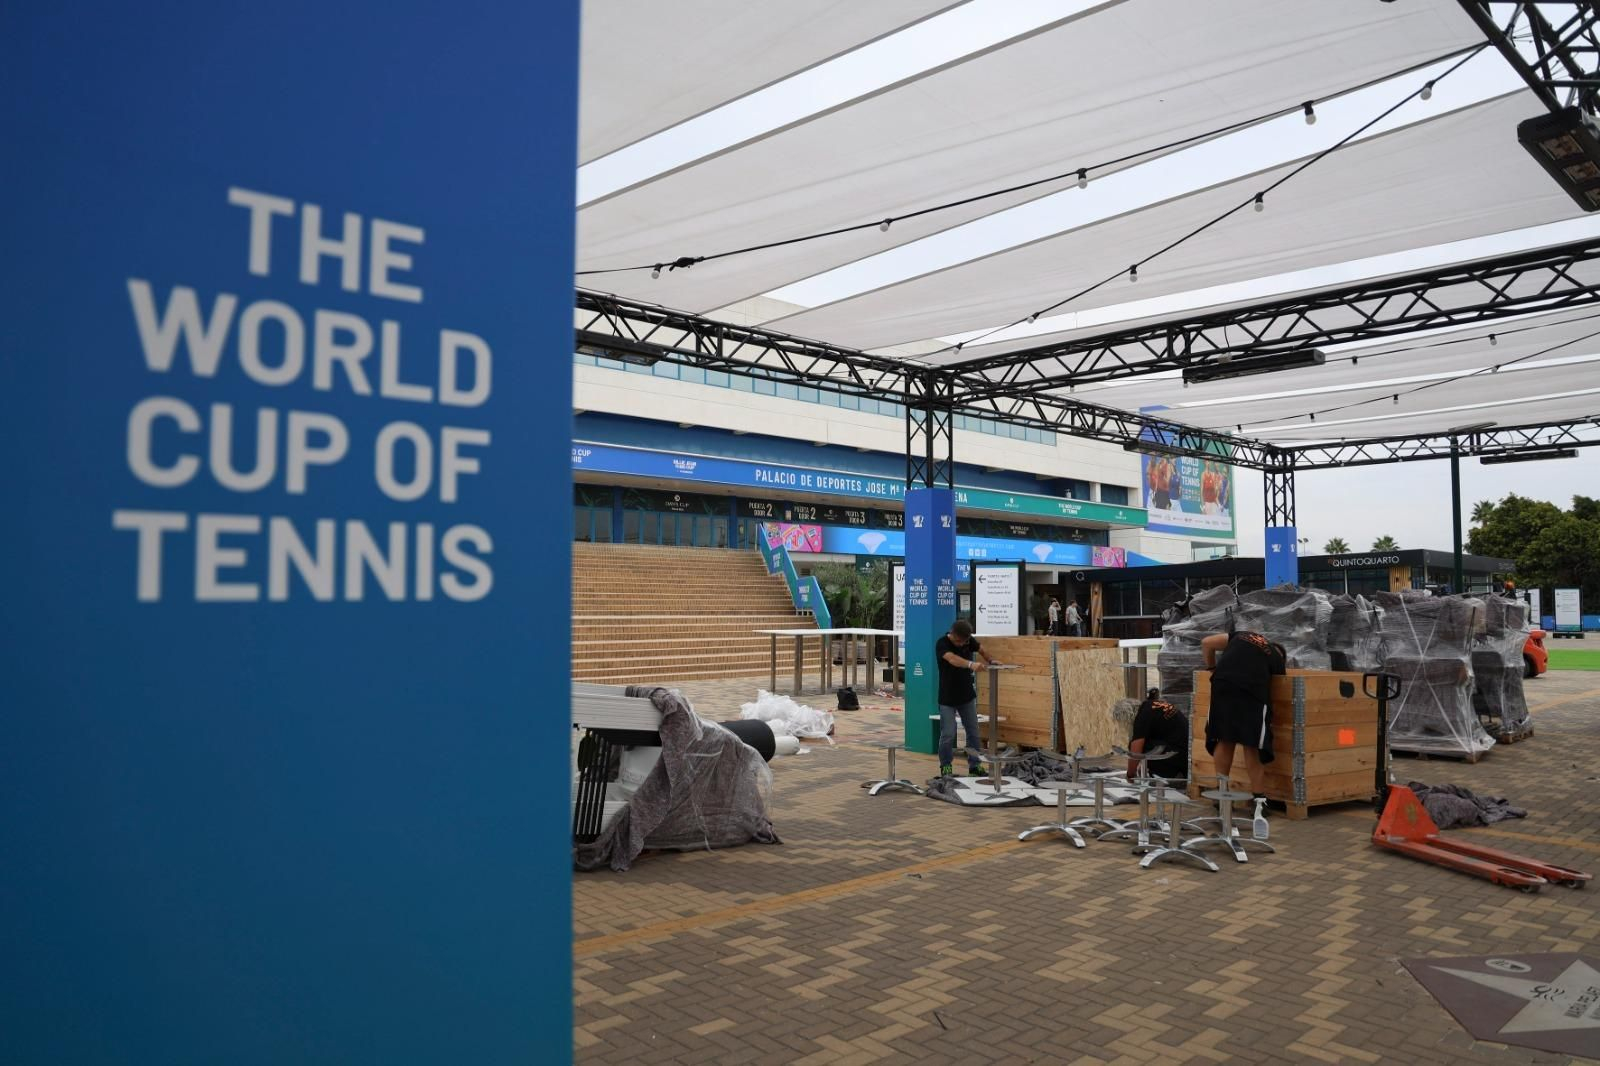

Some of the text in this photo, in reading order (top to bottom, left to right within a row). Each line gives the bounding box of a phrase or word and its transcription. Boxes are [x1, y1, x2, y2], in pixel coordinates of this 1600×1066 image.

[228, 187, 425, 303] THE
[127, 278, 493, 408] WORLD
[127, 395, 491, 503] CUP OF
[578, 449, 592, 457] CUP
[755, 469, 796, 485] PALACIO
[801, 474, 813, 487] DE
[816, 476, 862, 492] DEPORTES
[866, 482, 886, 495] JOSE
[766, 503, 773, 518] 2
[810, 507, 817, 520] 2
[860, 511, 866, 525] 3
[897, 514, 903, 527] 3
[113, 509, 494, 603] TENNIS
[1332, 555, 1399, 567] QUINTOQUARTO
